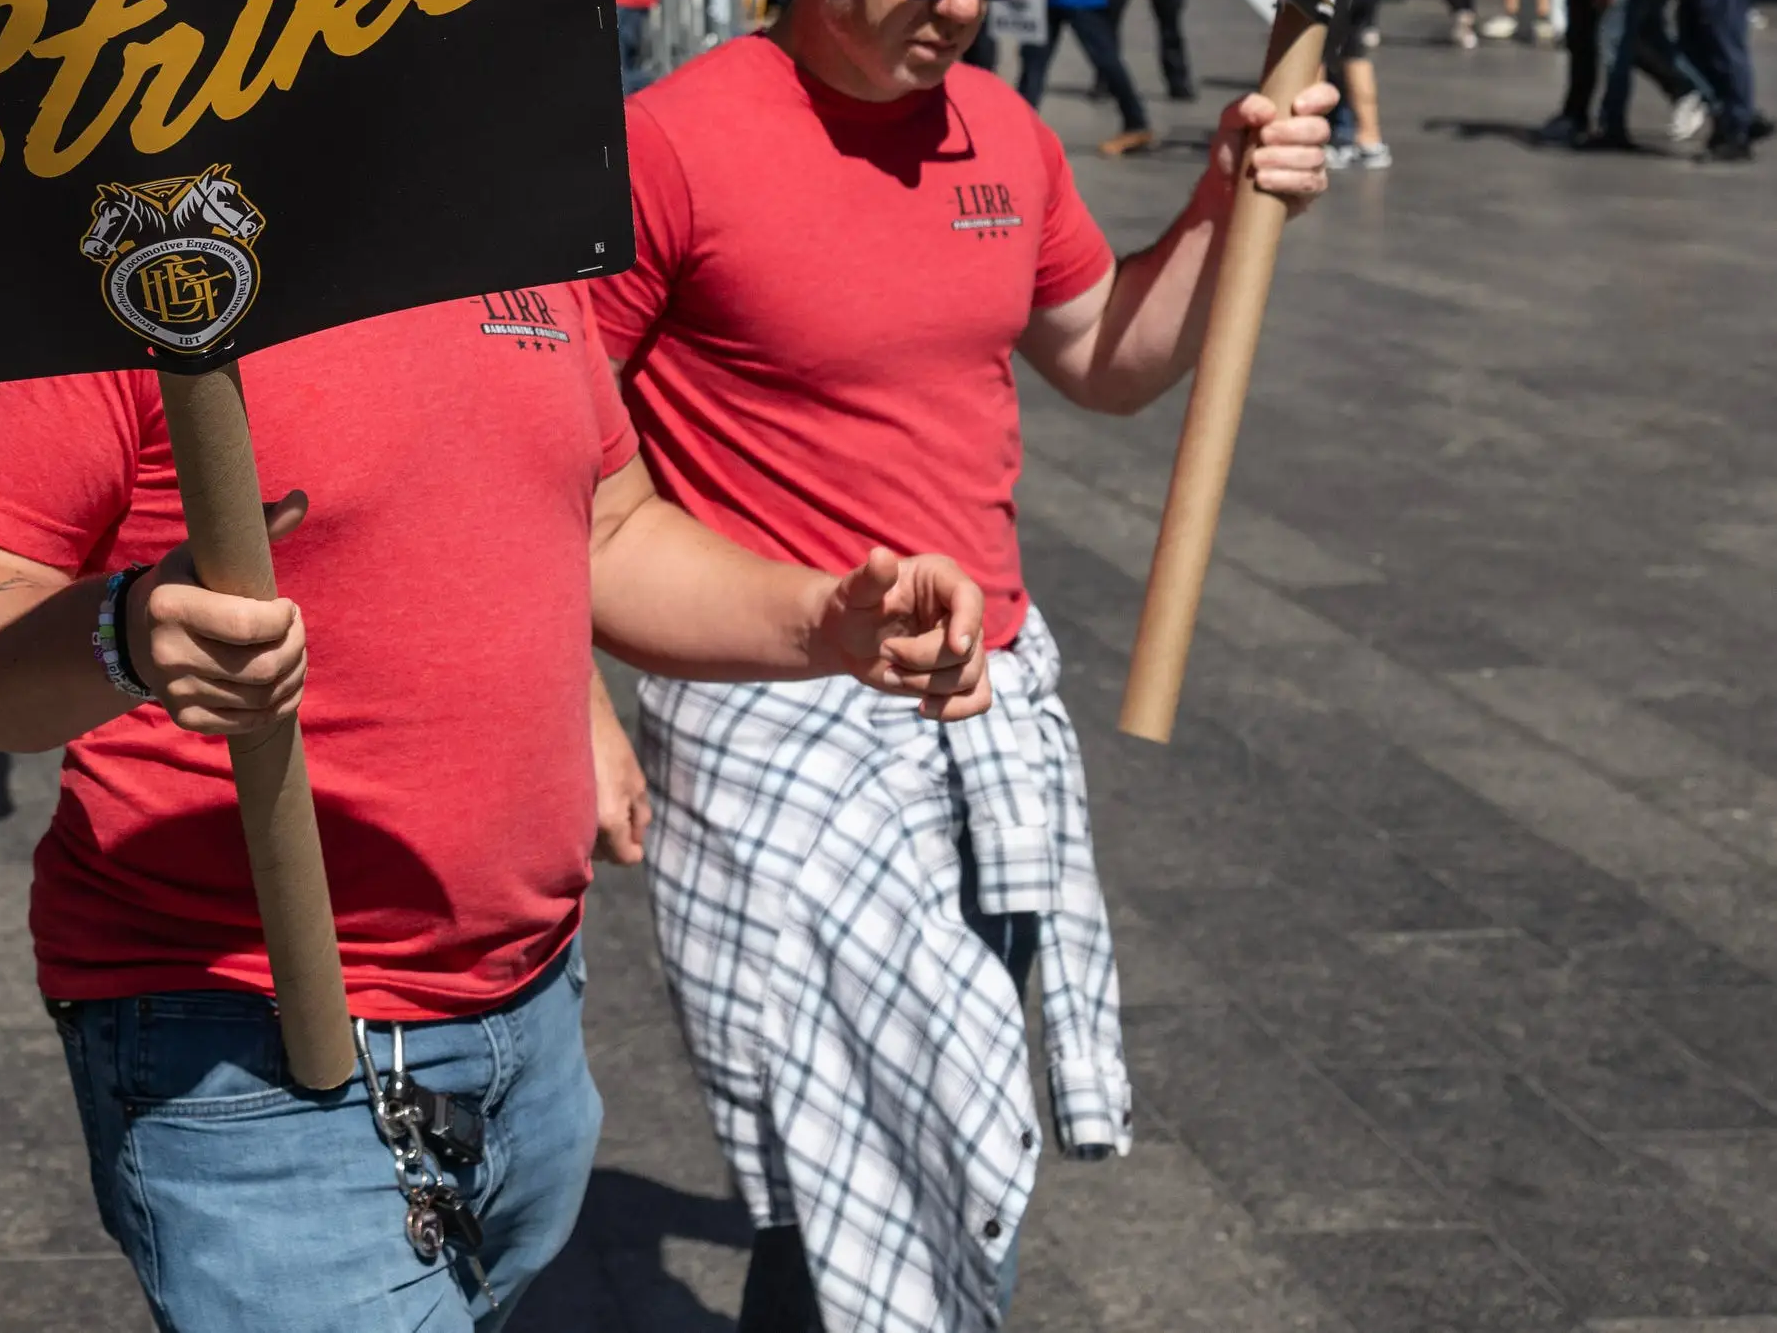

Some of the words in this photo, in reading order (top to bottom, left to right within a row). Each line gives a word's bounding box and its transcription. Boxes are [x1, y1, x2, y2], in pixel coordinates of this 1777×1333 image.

[954, 184, 1015, 216] LIRR
[124, 241, 183, 273] Locomotive
[186, 239, 238, 260] Engineers
[117, 271, 127, 282] of
[235, 259, 246, 274] and
[114, 281, 158, 333] Brotherhood
[220, 273, 249, 323] Trainmen
[482, 290, 557, 326] LIRR
[178, 335, 202, 345] IBT
